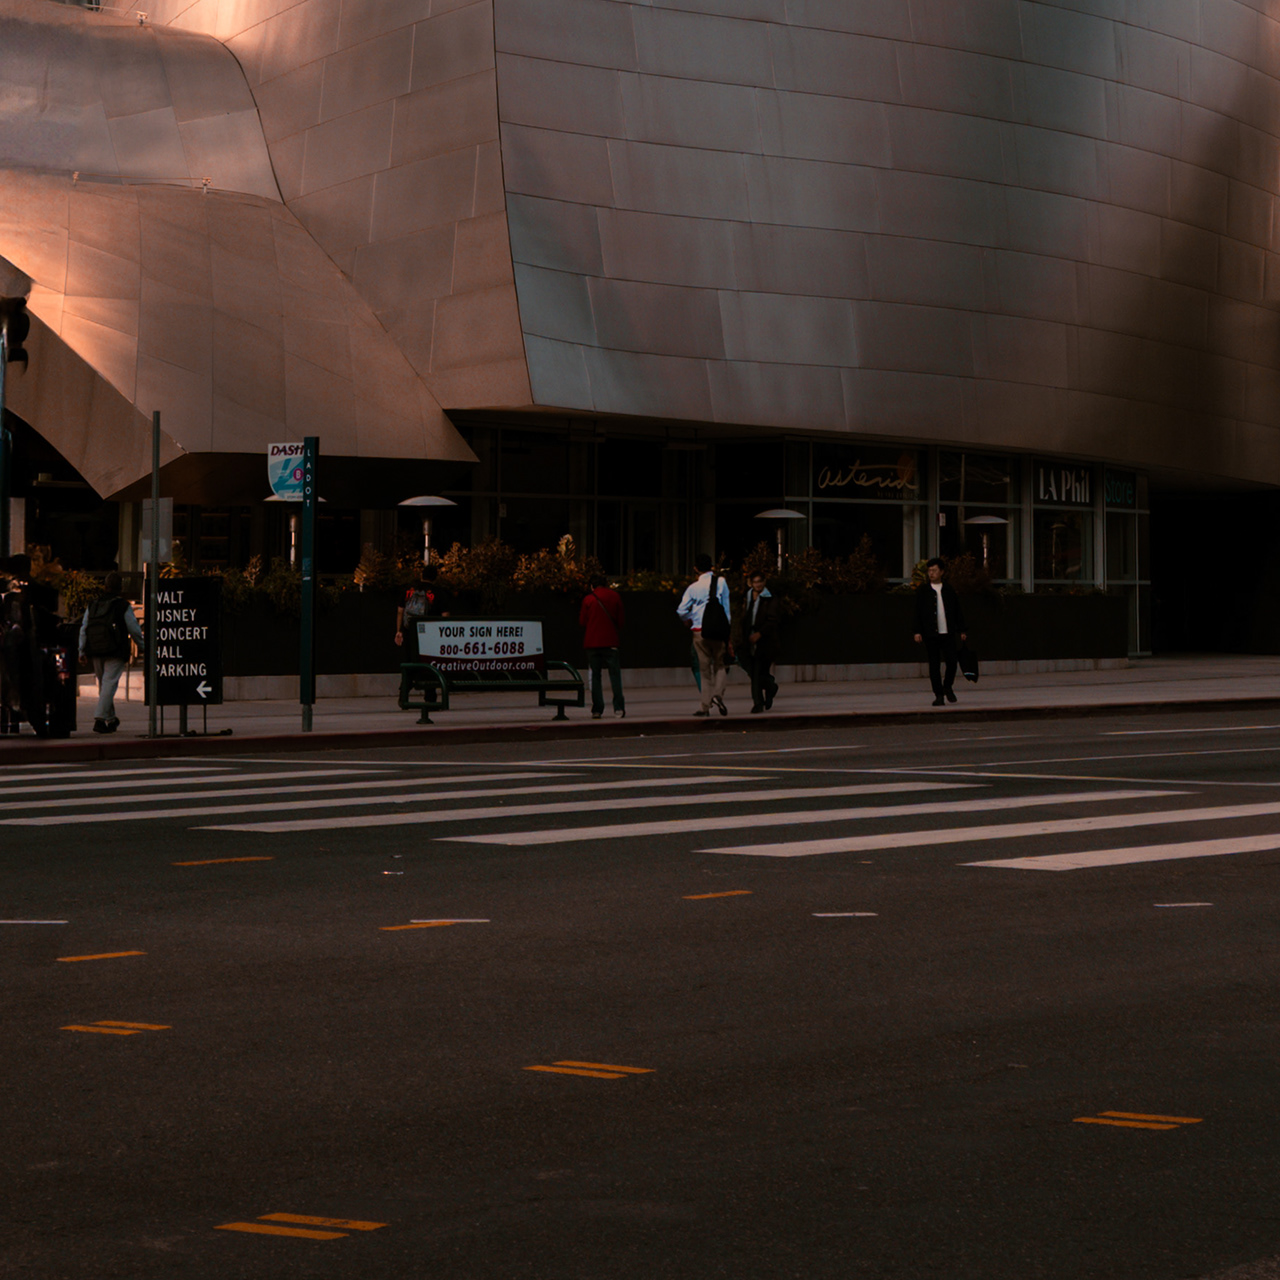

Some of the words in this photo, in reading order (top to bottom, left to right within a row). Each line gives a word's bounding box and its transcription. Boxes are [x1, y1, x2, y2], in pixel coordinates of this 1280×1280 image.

[271, 445, 304, 456] DASH
[1040, 467, 1058, 501] LA
[1061, 468, 1090, 503] Phil
[1105, 469, 1134, 504] Store
[439, 626, 465, 637] YOUR
[470, 626, 492, 637] SIGN
[496, 626, 523, 637] HERE!
[440, 642, 525, 655] 800-661-6088
[430, 660, 536, 671] CreativeOutdoor.com
